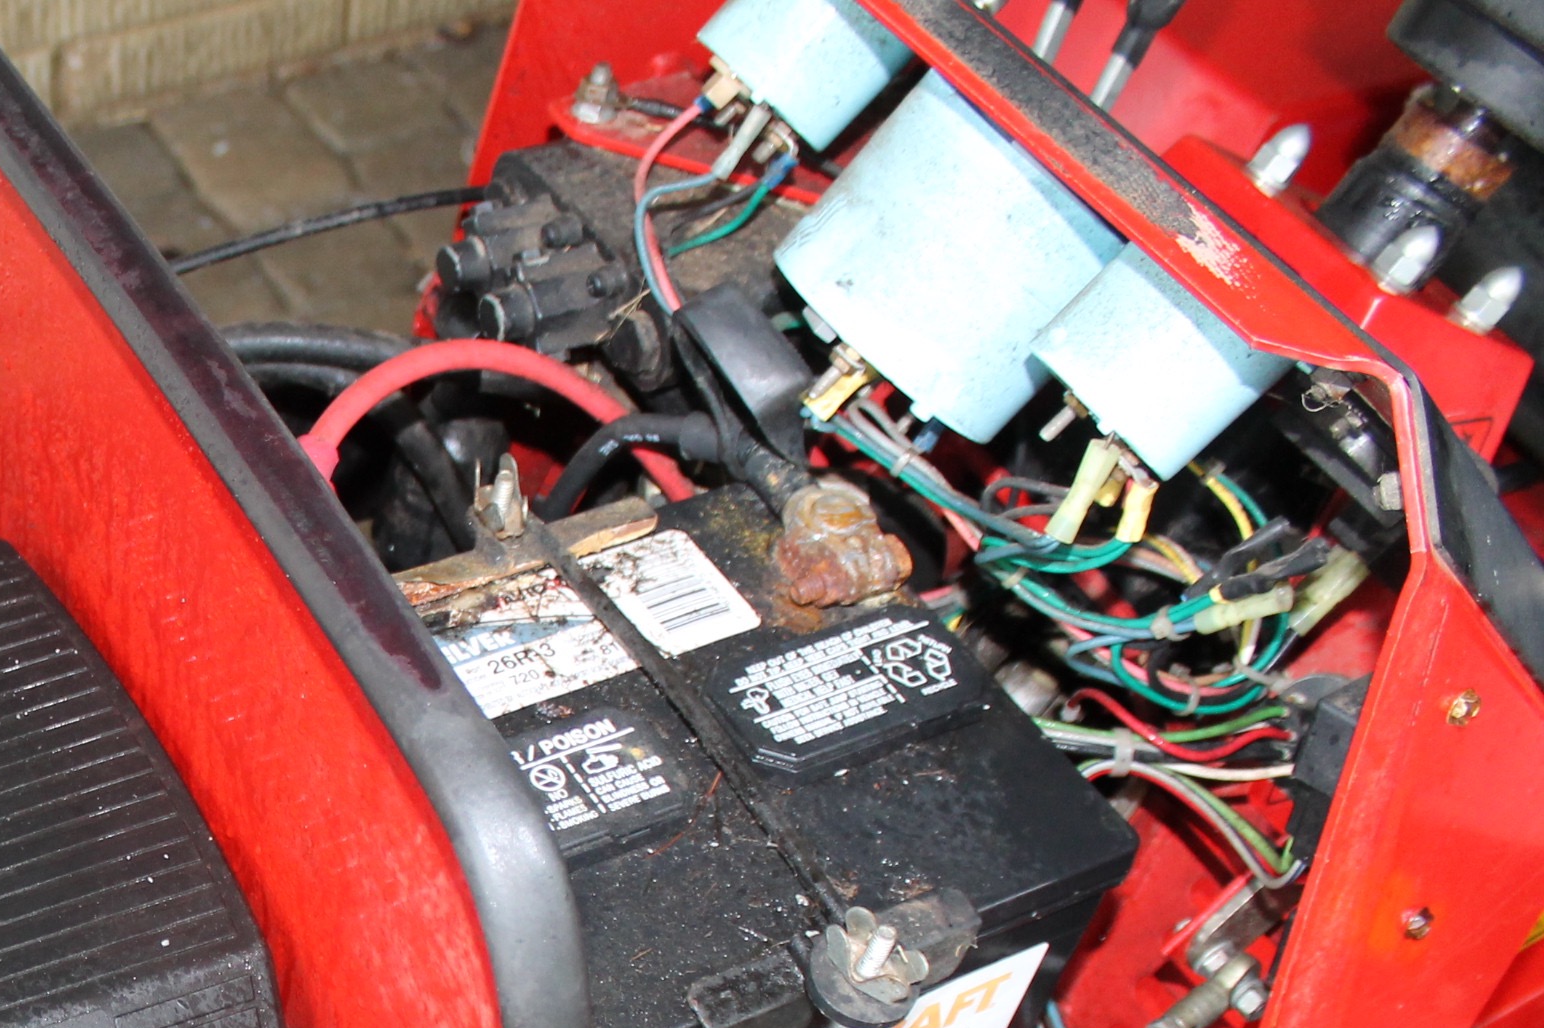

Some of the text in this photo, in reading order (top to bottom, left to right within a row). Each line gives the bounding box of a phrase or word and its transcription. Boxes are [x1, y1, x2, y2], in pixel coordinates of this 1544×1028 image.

[508, 669, 540, 686] 720
[538, 718, 617, 756] POISON
[587, 755, 664, 788] SULFURIC ACID
[547, 789, 569, 802] NO
[594, 780, 616, 796] CAN
